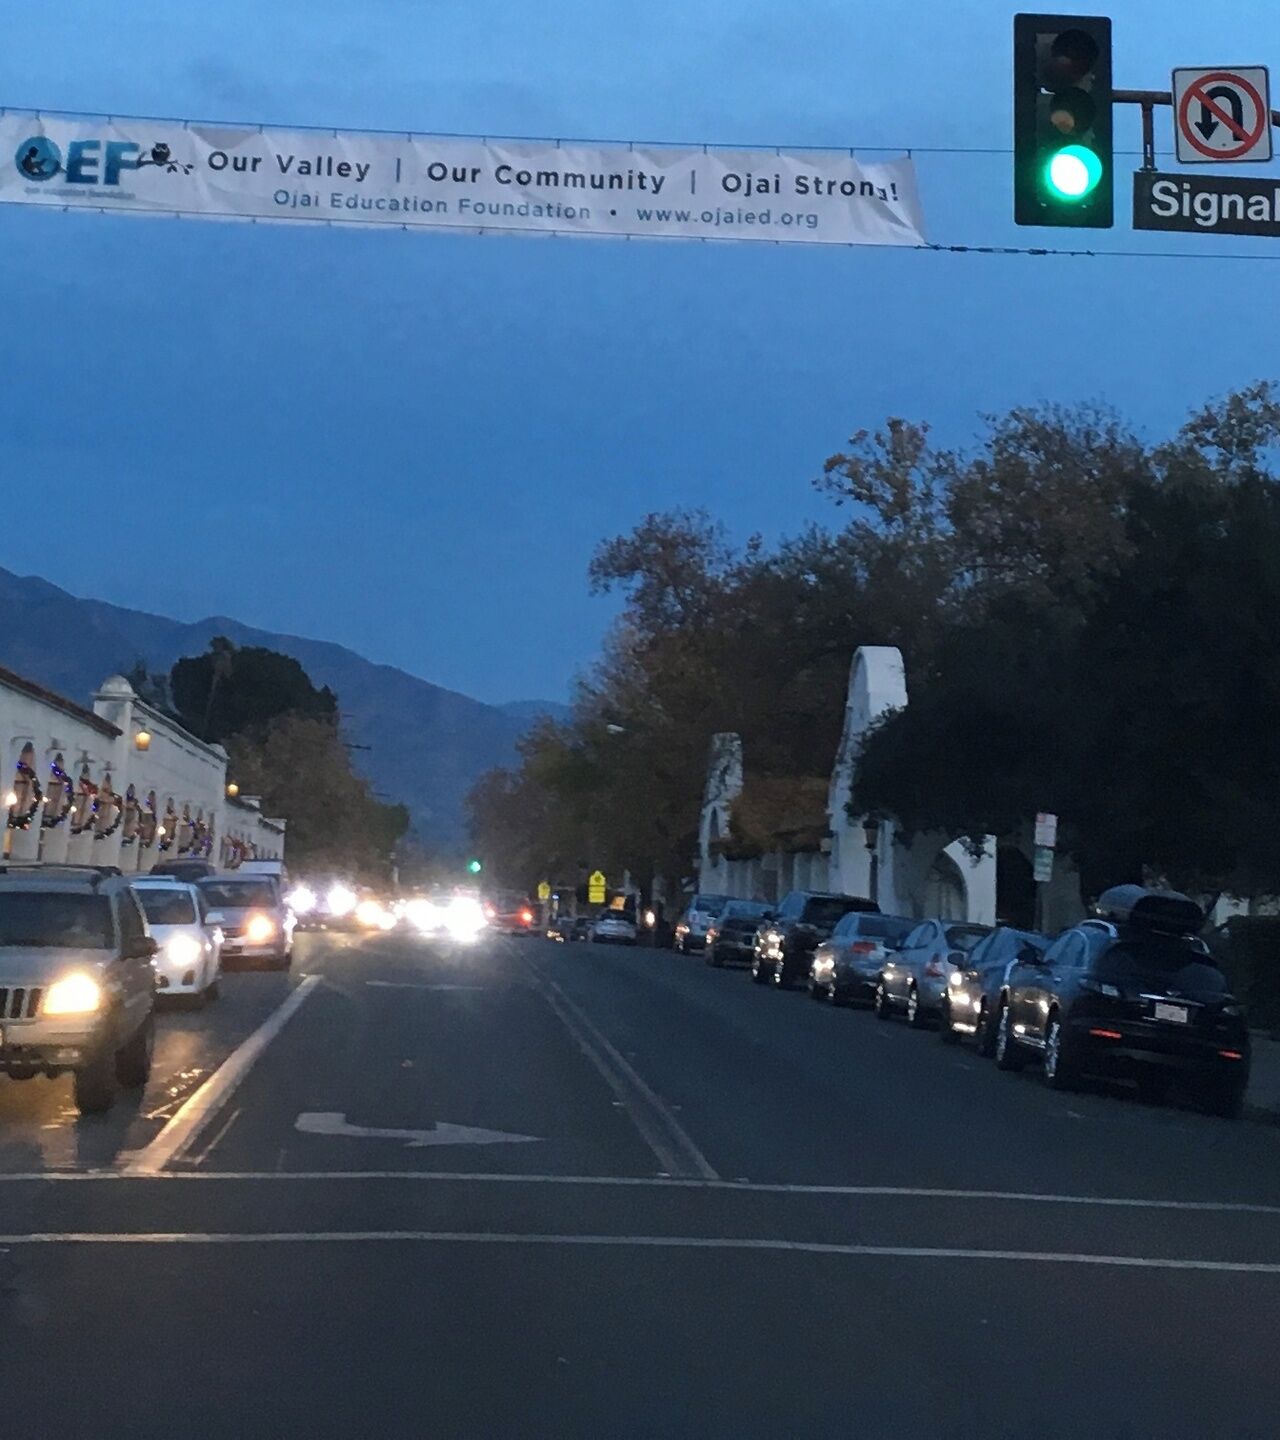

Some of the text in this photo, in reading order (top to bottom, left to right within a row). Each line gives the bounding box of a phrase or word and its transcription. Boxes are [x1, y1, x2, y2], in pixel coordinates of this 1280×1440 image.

[15, 136, 140, 186] OEF
[208, 151, 370, 182] Our Valley
[427, 162, 666, 194] Our Community
[722, 173, 781, 197] Ojai
[273, 189, 591, 220] Ojai Education Foundation
[637, 208, 819, 229] www.ojaied.org
